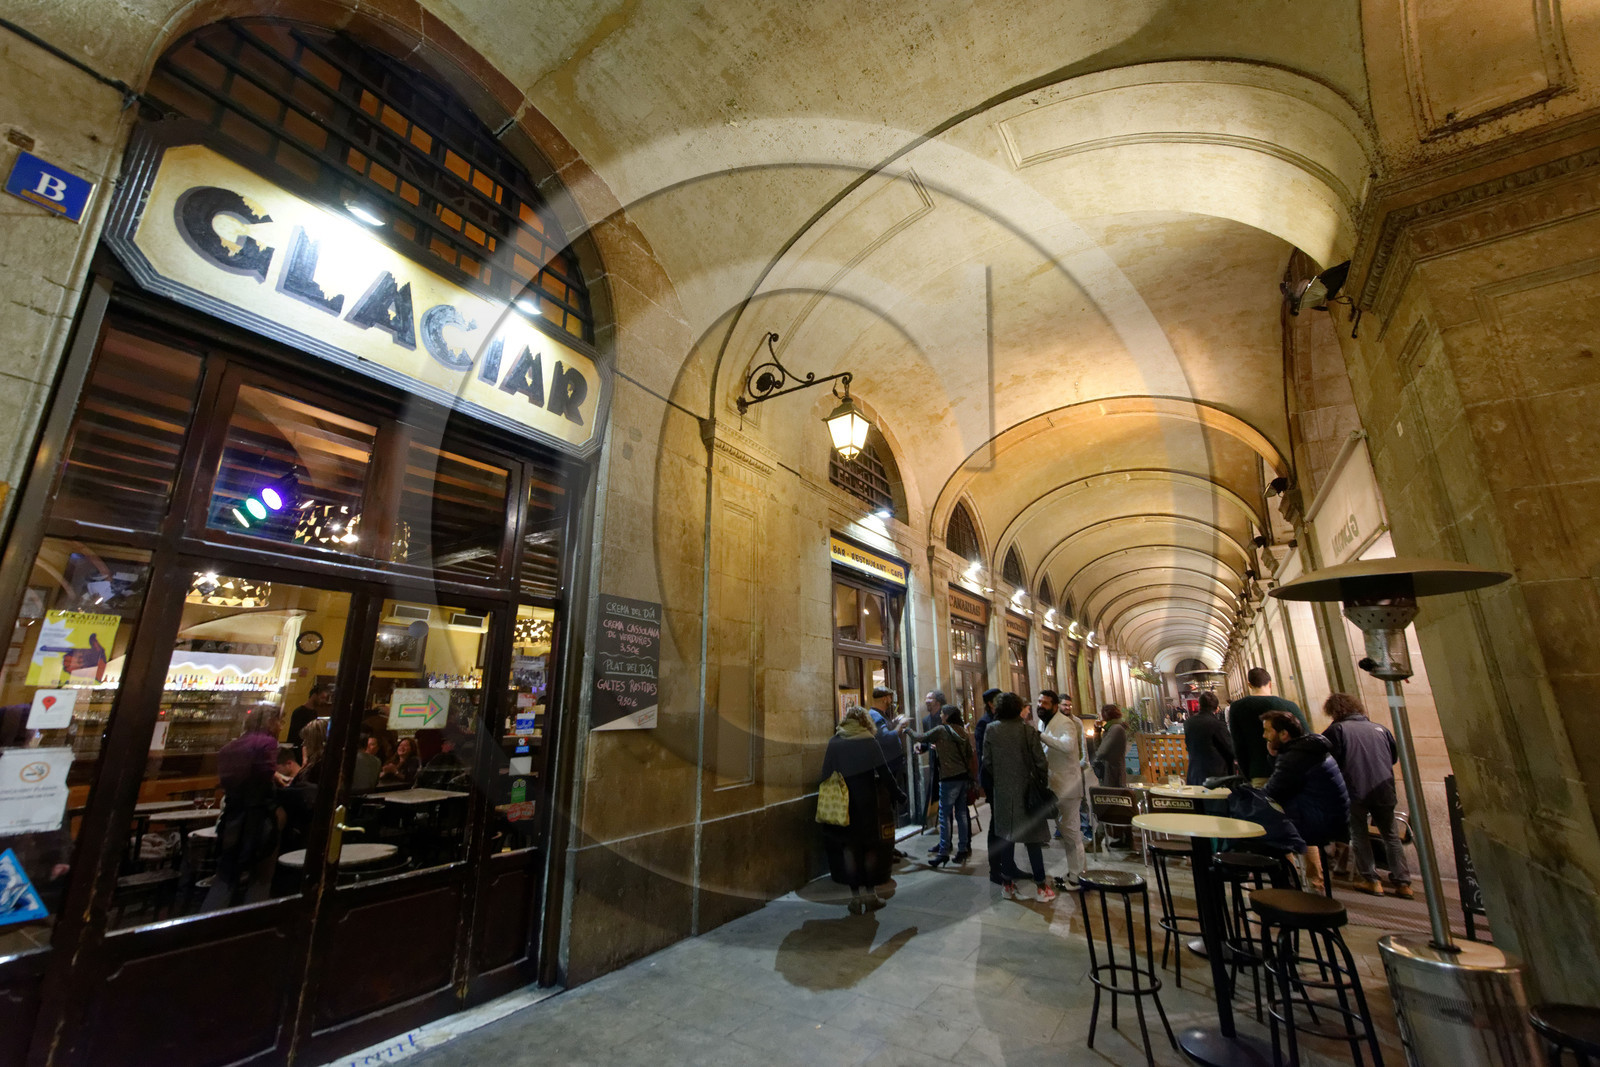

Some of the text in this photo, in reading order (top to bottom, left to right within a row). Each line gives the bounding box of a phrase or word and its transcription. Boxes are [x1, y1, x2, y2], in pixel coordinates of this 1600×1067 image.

[33, 171, 67, 201] B
[173, 185, 588, 426] GLACIAR
[832, 544, 846, 557] BAR
[851, 552, 887, 572] RESTAURANT
[606, 602, 629, 614] CREMA
[631, 607, 641, 616] DEL
[603, 619, 660, 639] CREMA CASSOLANA
[619, 633, 653, 648] VERDURES
[603, 658, 624, 671] PLAT
[626, 663, 637, 672] DEL
[597, 678, 657, 696] GALTES ROSTIDES
[1095, 796, 1130, 805] GLACIAR
[1154, 799, 1191, 808] GLACIAR
